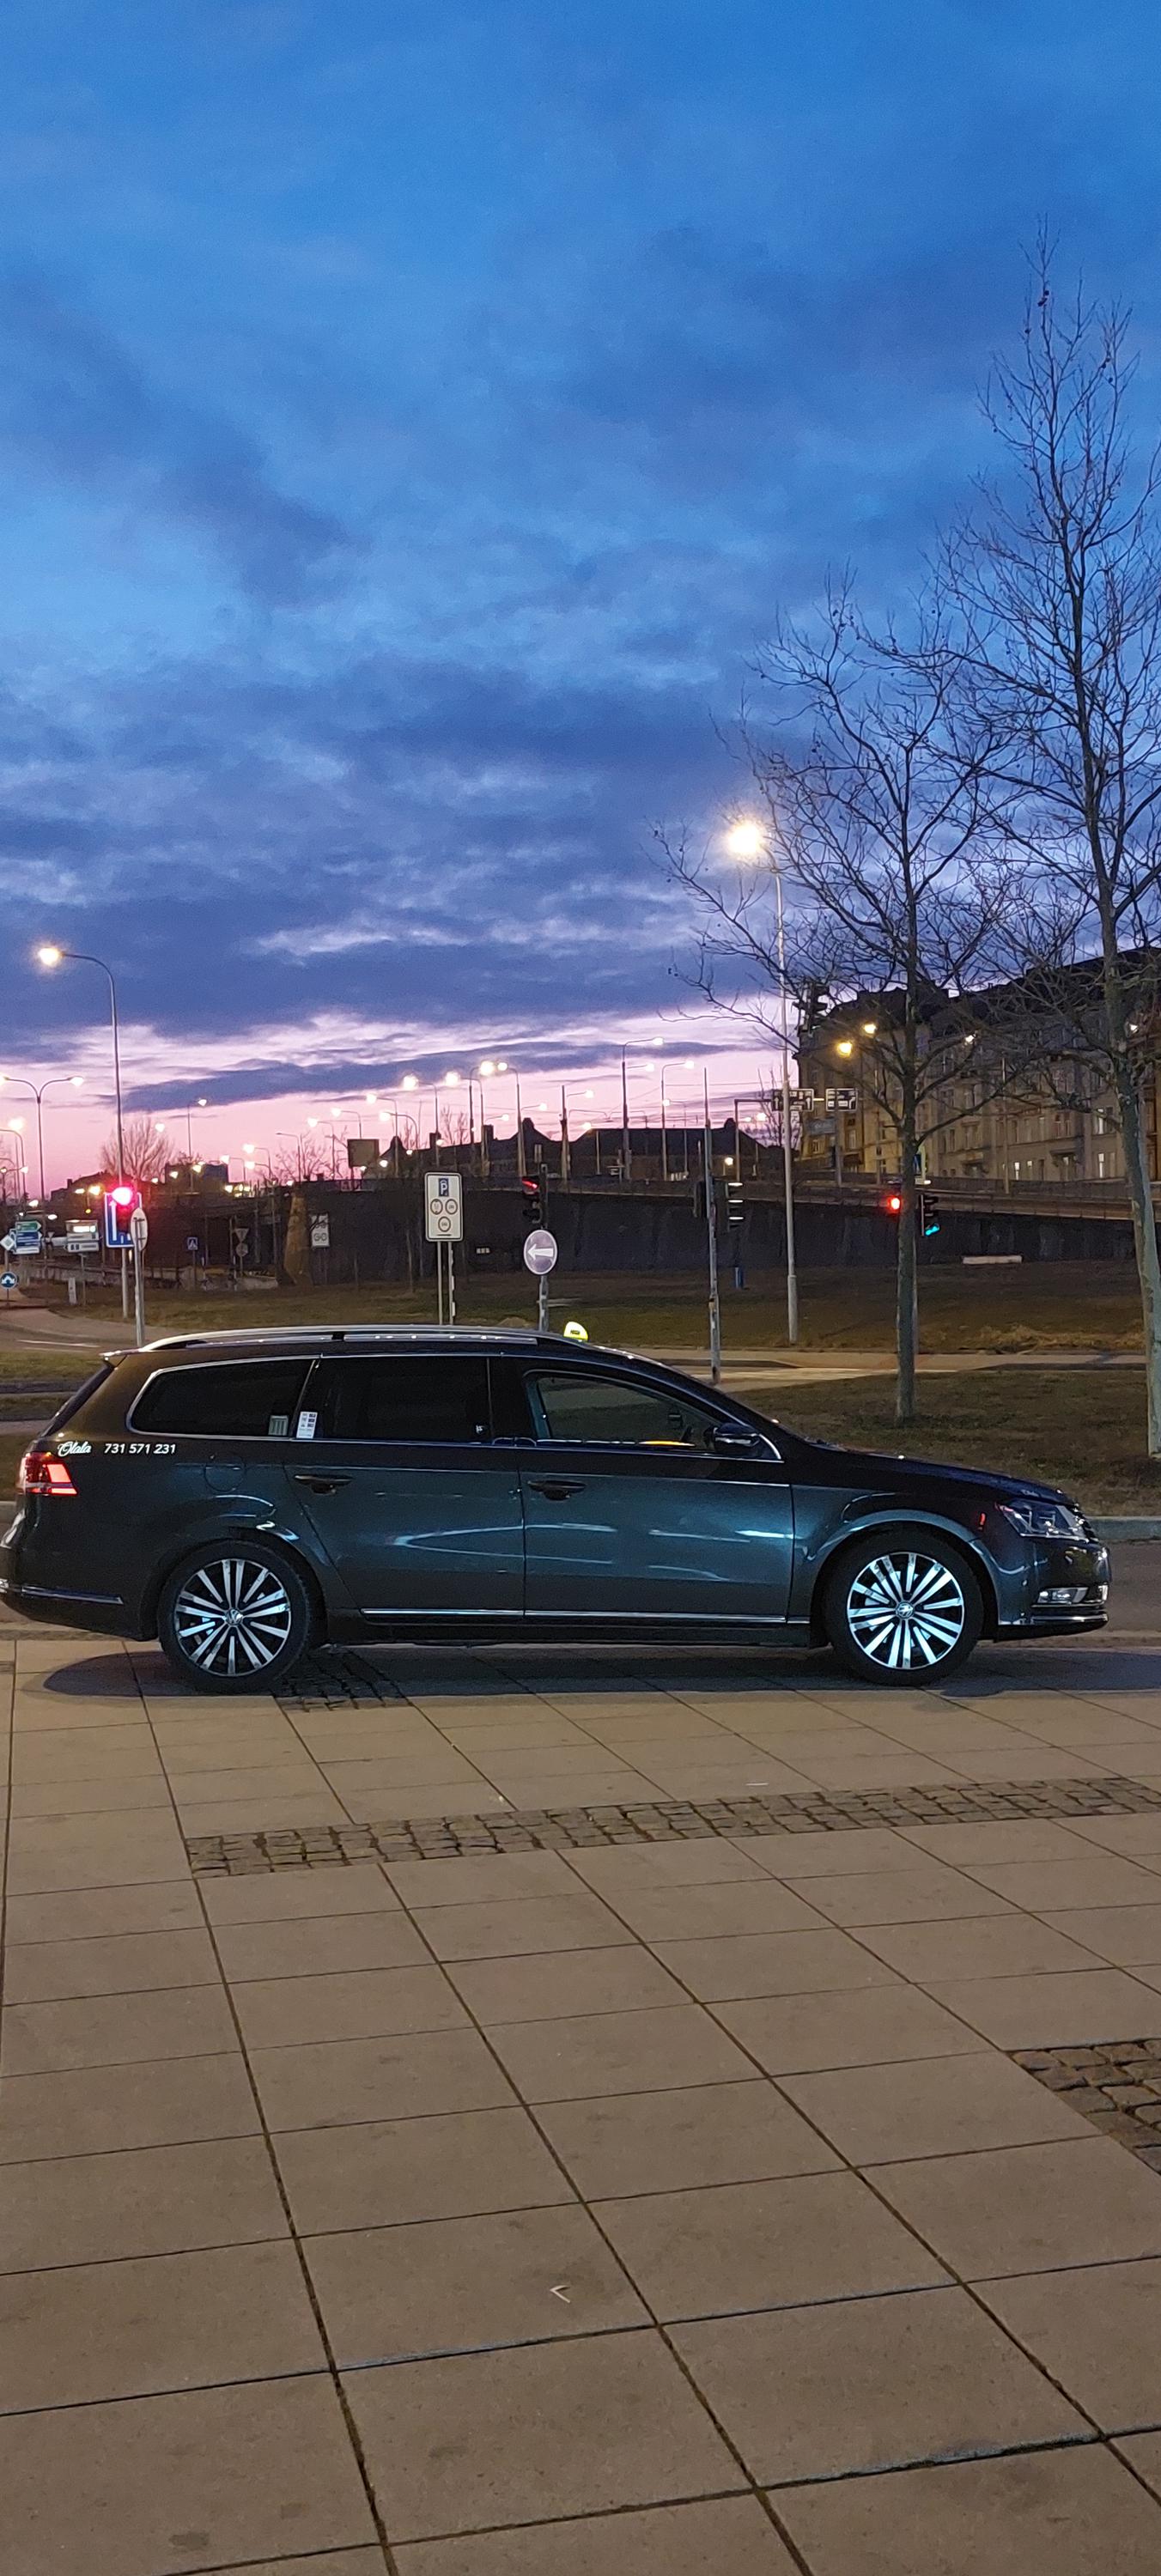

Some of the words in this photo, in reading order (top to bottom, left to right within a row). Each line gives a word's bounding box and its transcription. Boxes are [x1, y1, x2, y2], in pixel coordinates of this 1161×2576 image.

[104, 1443, 125, 1454] 731
[129, 1443, 150, 1455] 571
[153, 1443, 176, 1455] 231
